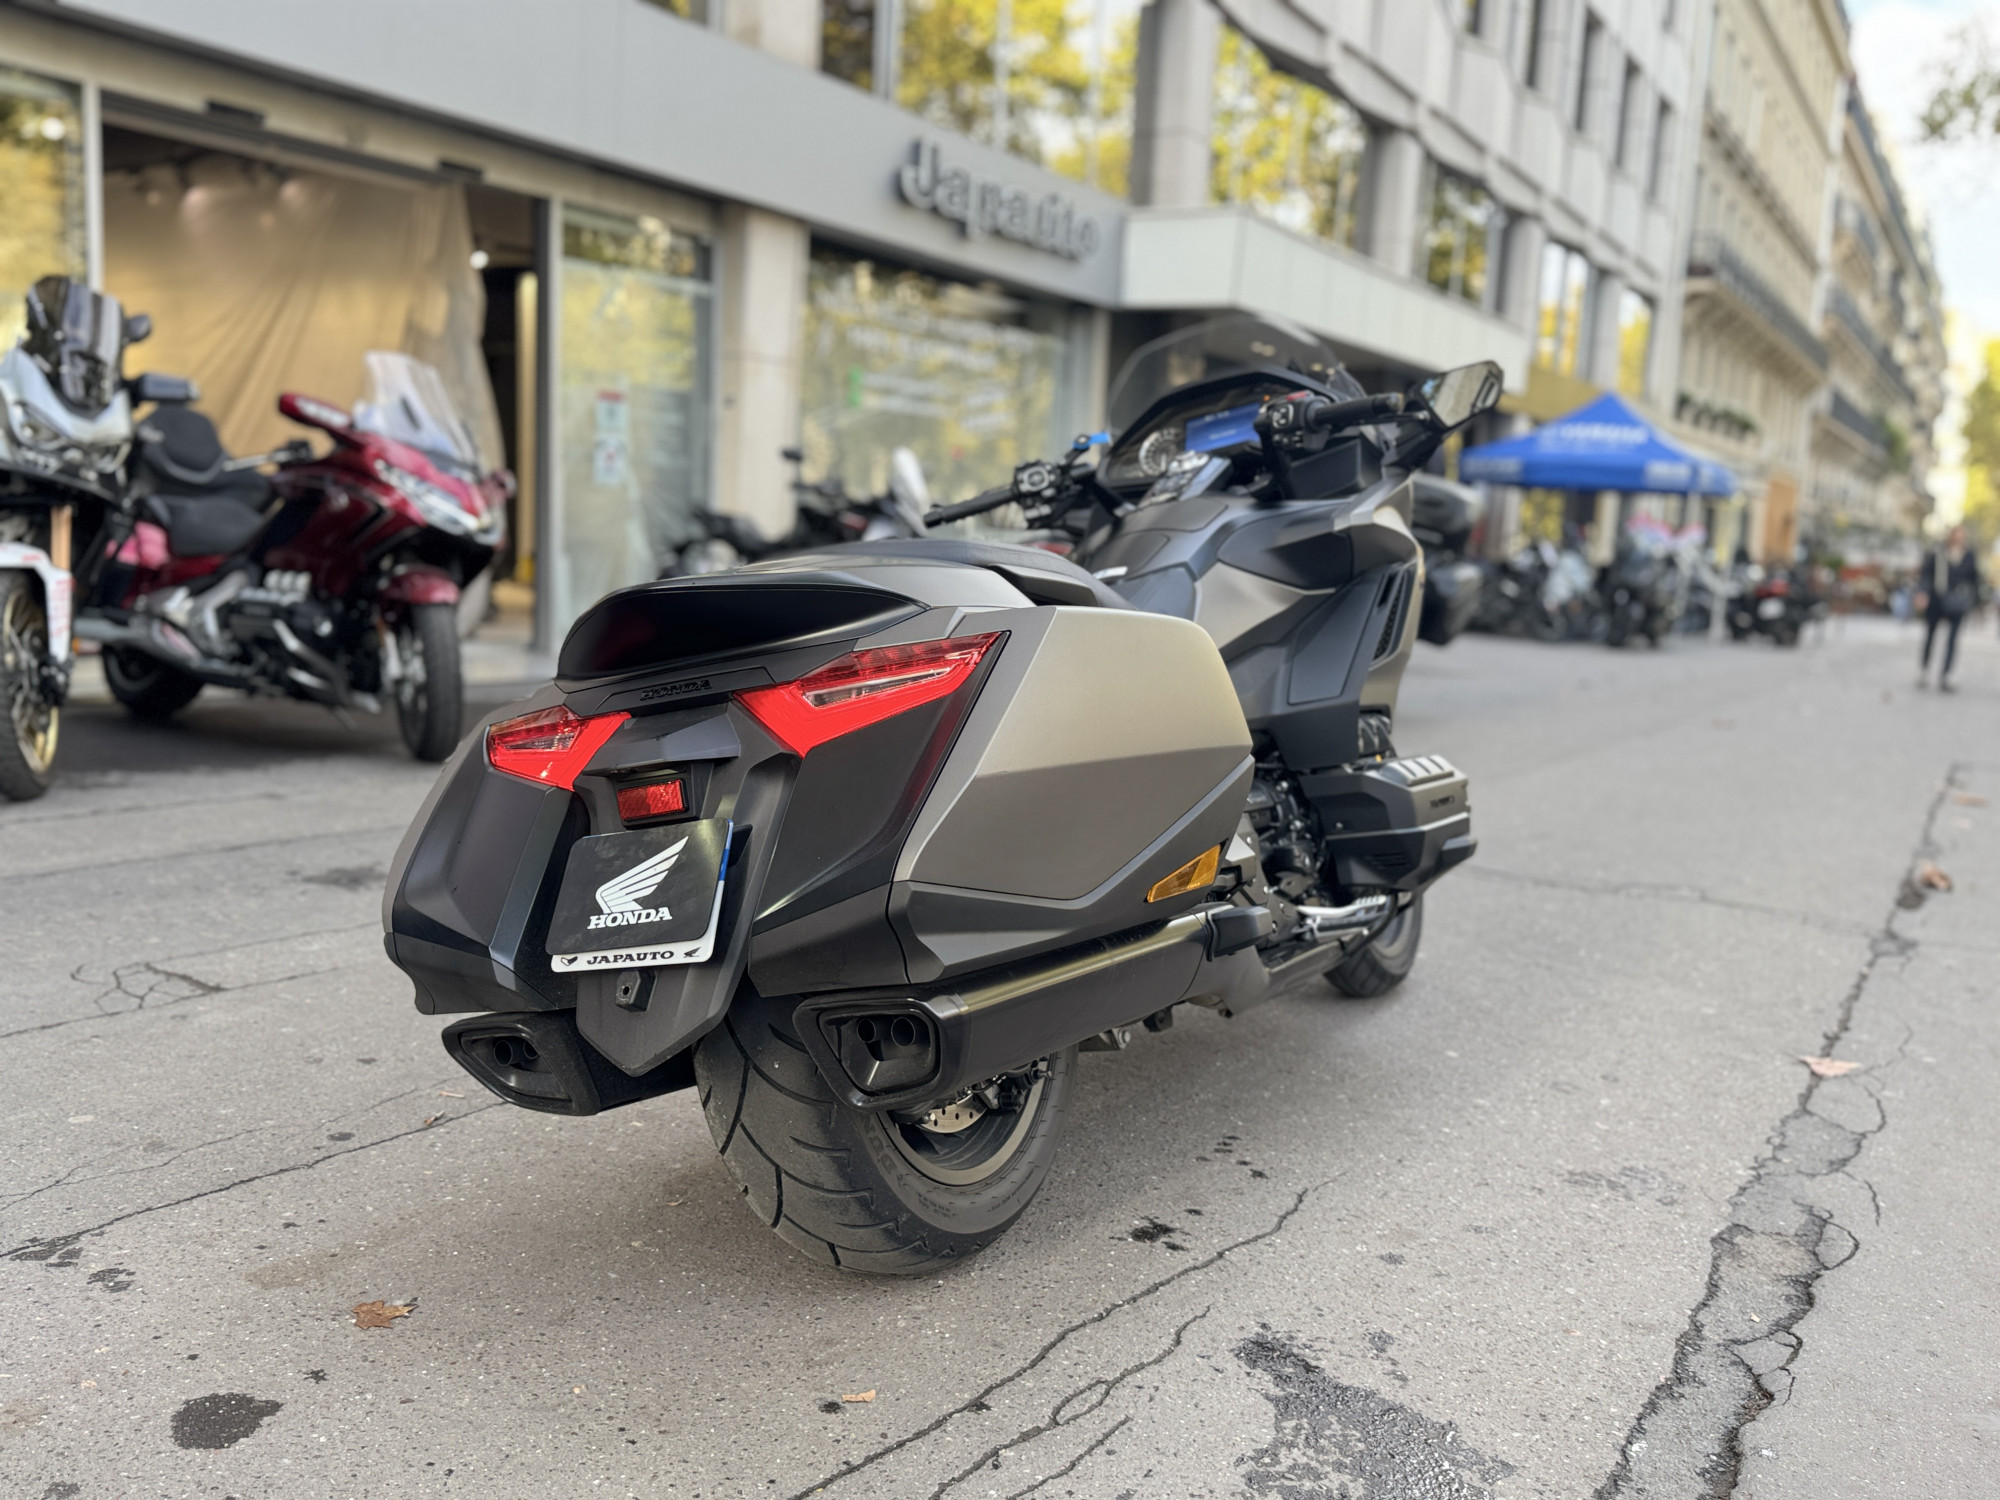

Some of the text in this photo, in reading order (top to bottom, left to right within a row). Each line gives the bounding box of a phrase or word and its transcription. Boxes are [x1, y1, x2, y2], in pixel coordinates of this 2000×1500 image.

[893, 138, 1101, 262] Japauto
[640, 680, 712, 700] HONDA
[587, 907, 673, 929] HONDA
[586, 951, 675, 965] JAPAUTO
